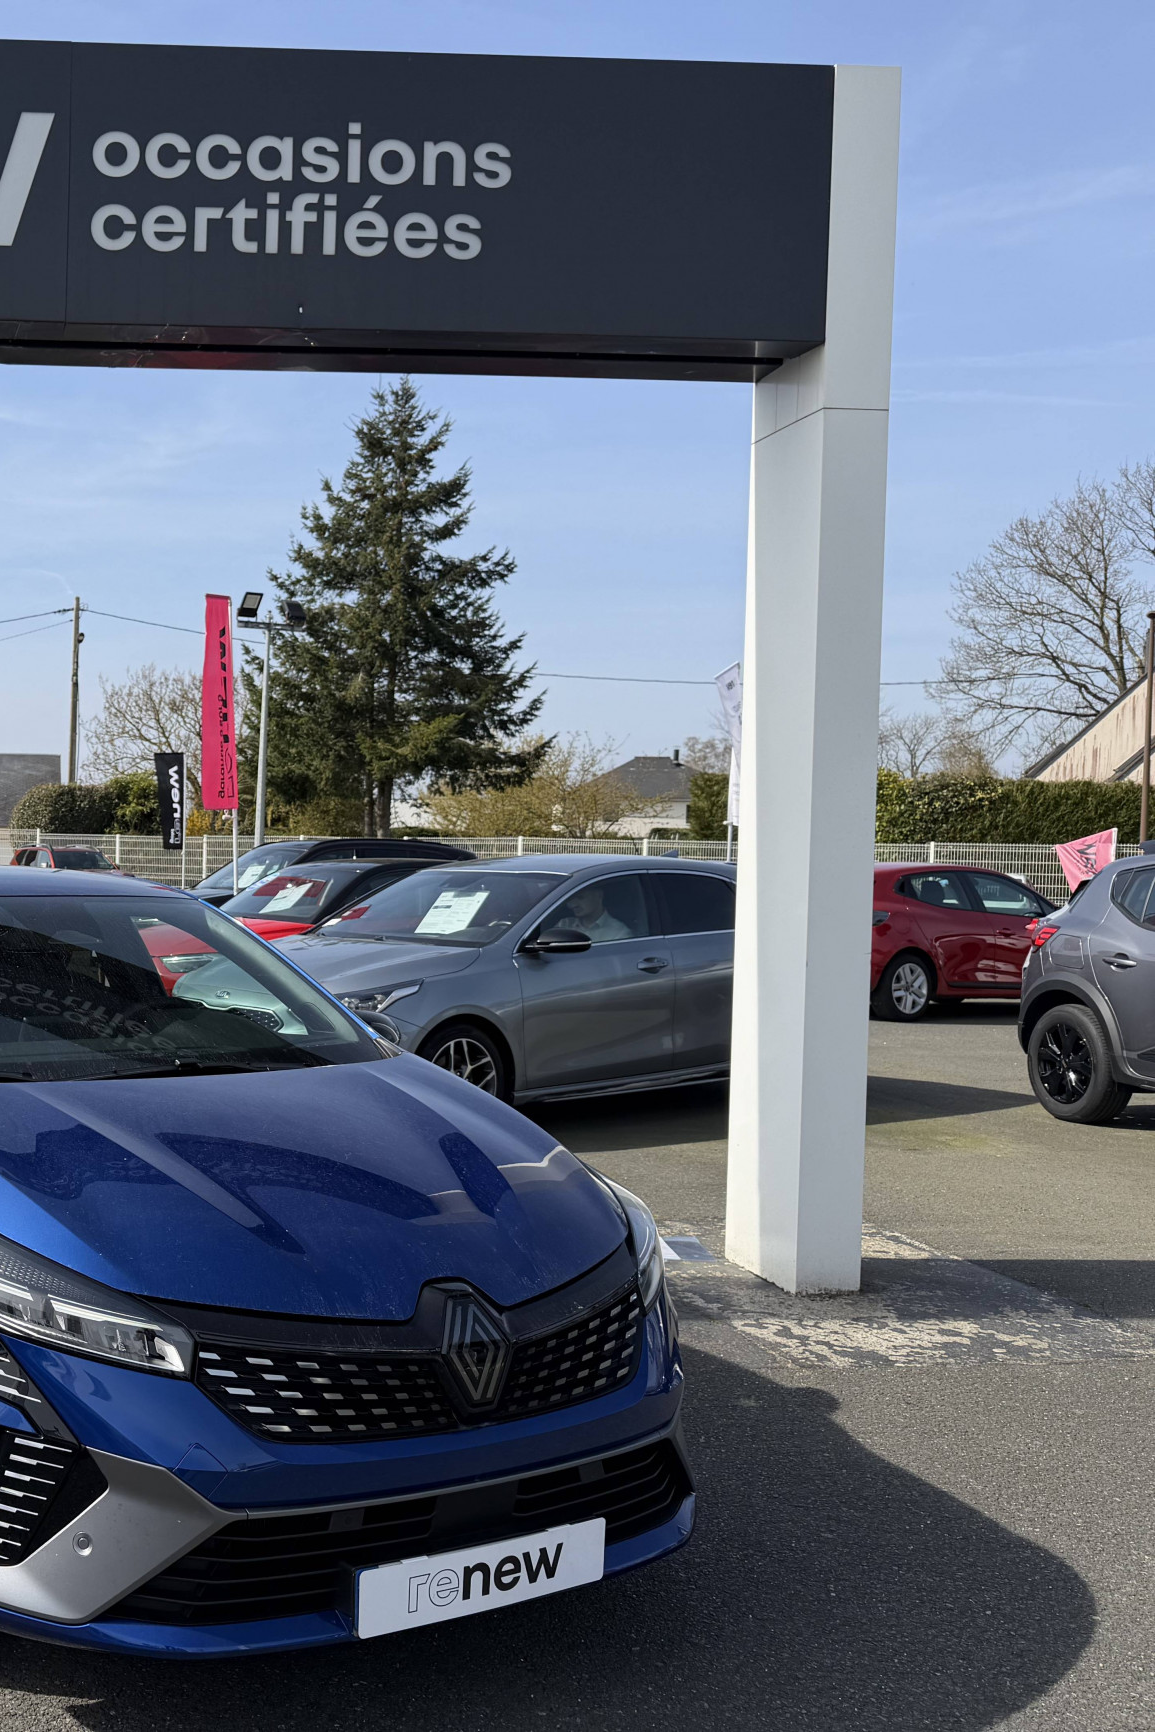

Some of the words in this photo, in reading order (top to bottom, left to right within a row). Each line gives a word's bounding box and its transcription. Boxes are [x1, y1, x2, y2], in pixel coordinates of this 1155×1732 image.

[92, 121, 512, 189] occasions
[90, 191, 483, 260] certifiées
[408, 1542, 564, 1613] renew
